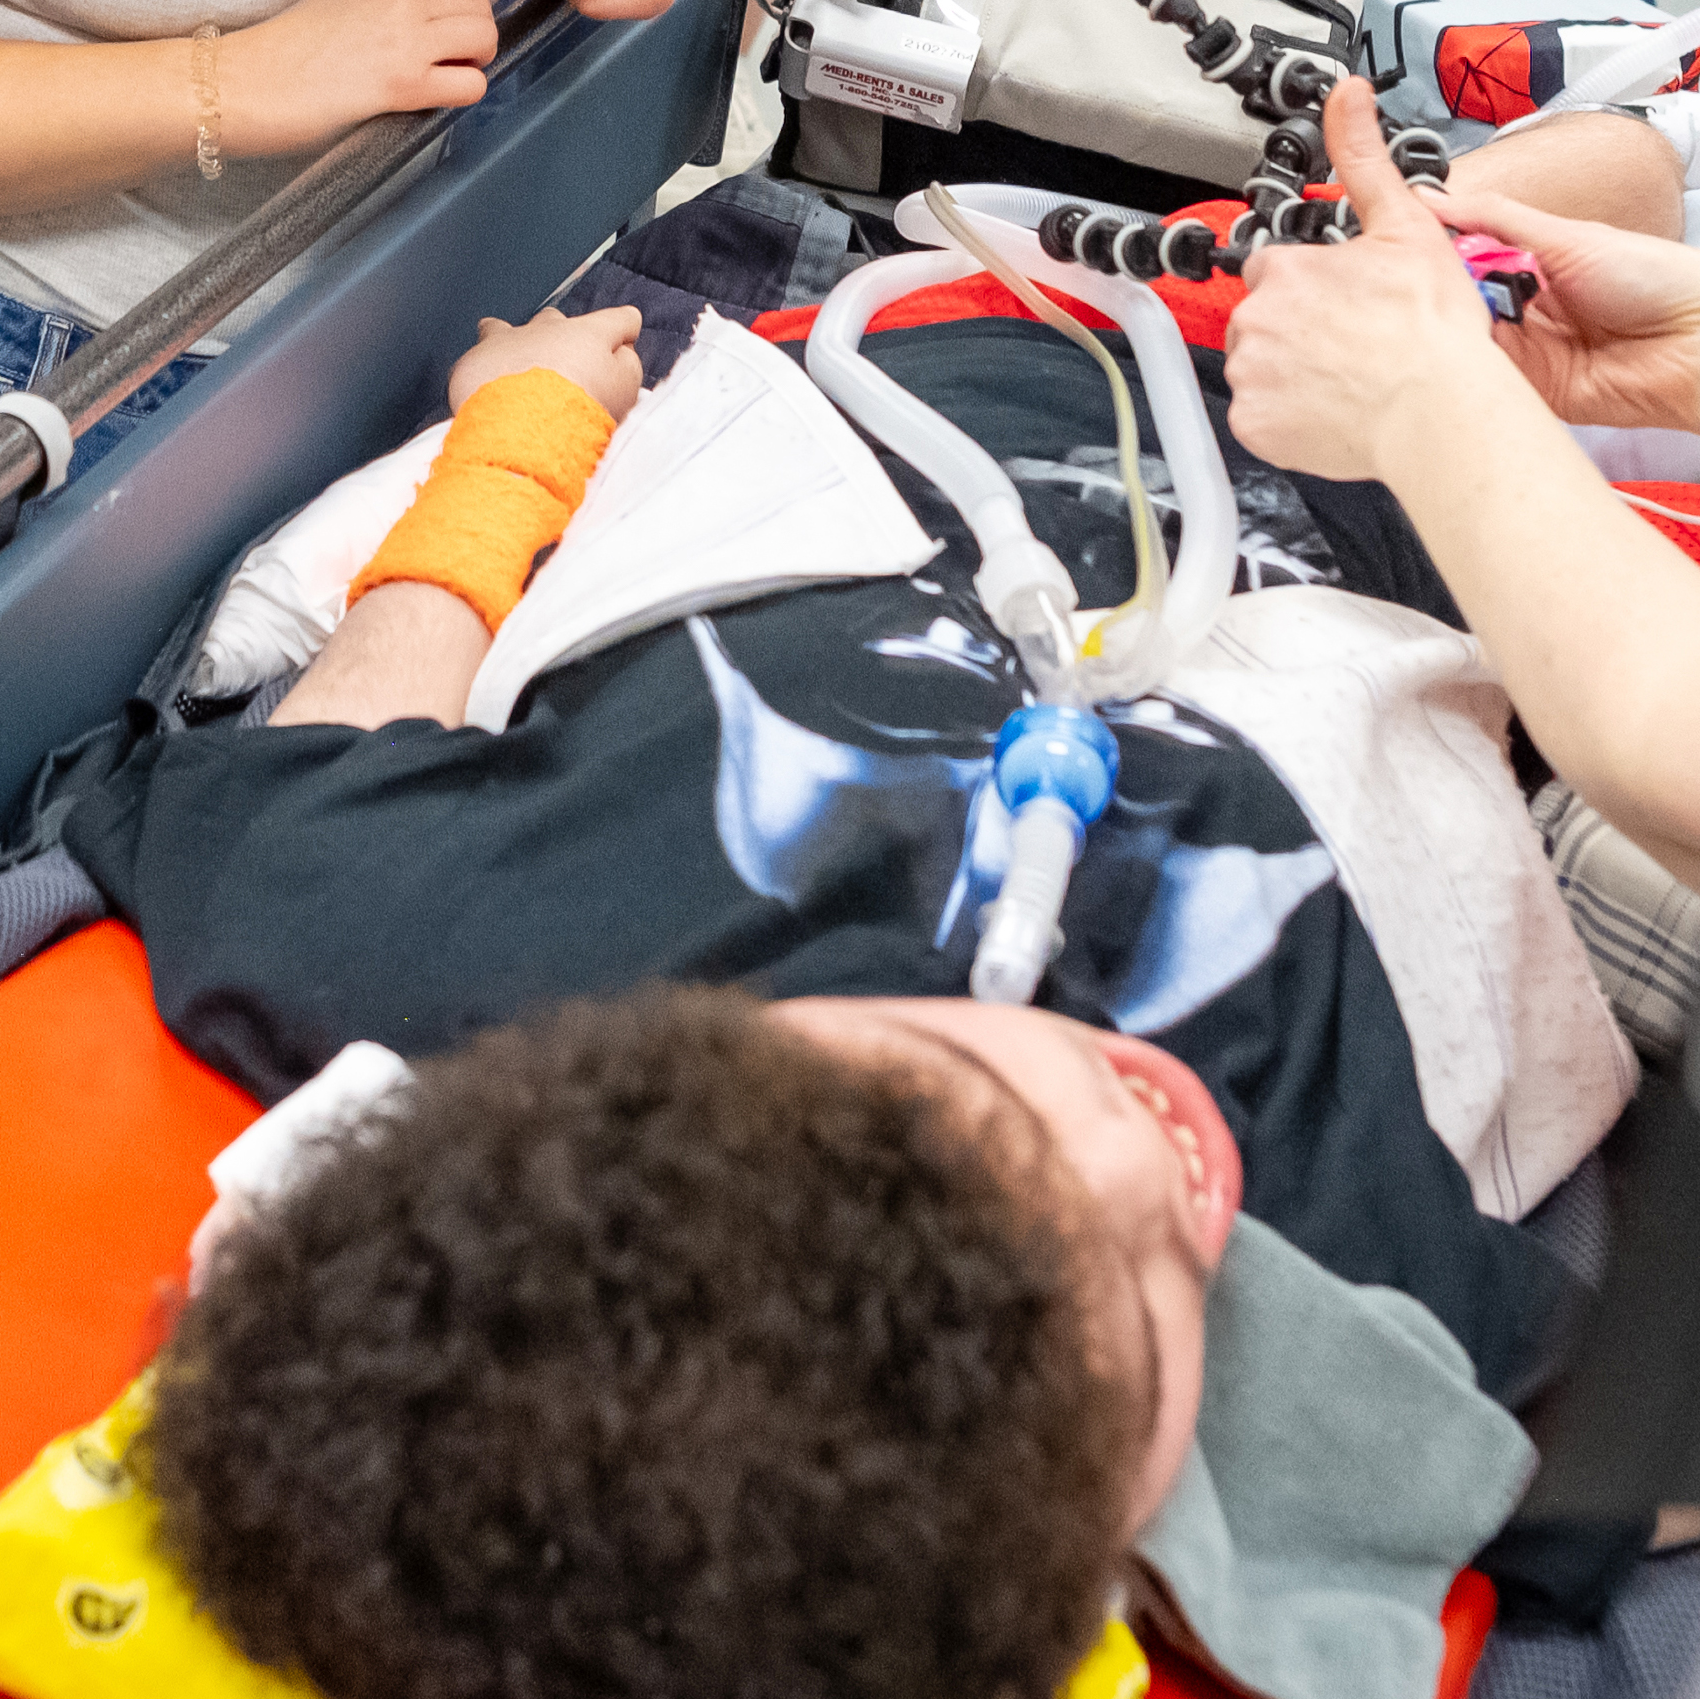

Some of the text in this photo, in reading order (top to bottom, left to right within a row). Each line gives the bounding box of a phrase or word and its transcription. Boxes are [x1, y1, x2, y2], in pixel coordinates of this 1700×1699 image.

[820, 63, 894, 90] MEDI-RENTS
[897, 84, 906, 94] &
[908, 86, 945, 105] SALES
